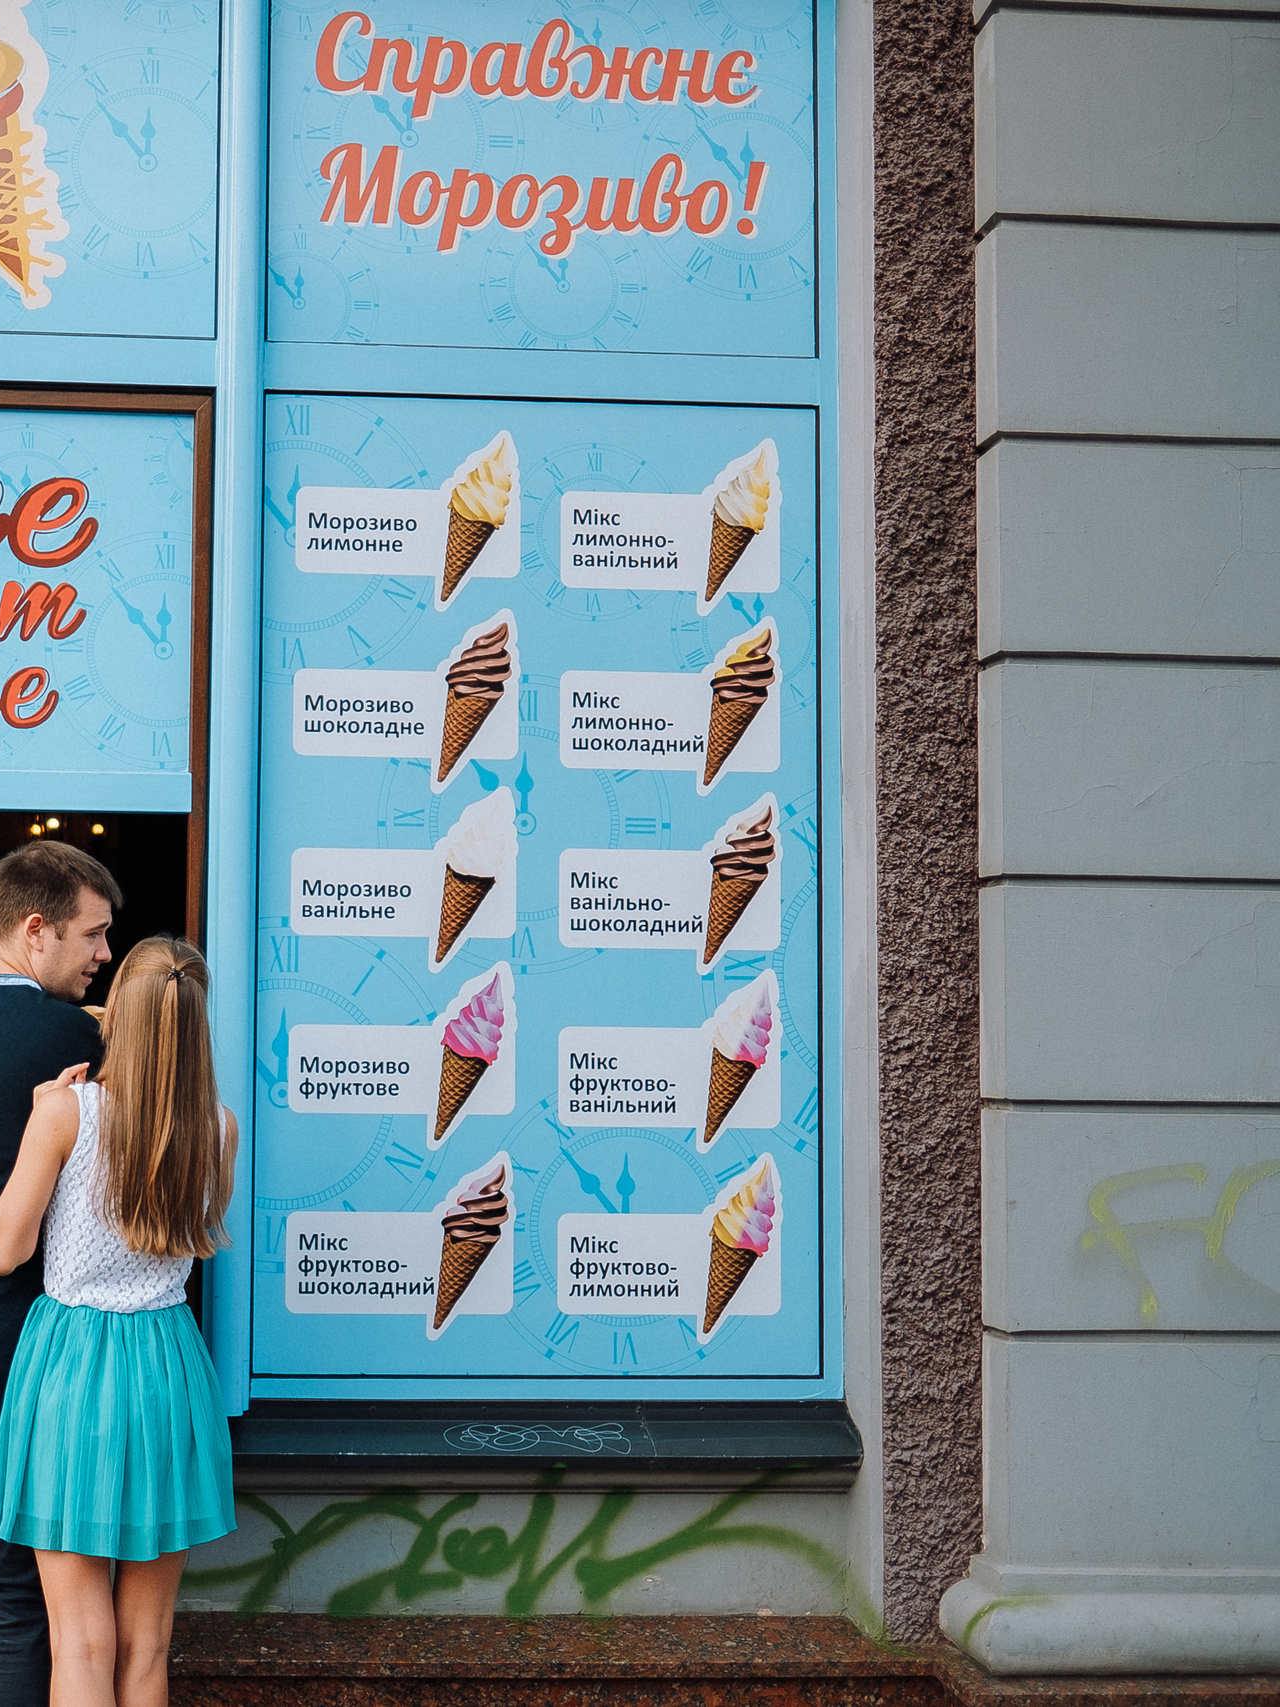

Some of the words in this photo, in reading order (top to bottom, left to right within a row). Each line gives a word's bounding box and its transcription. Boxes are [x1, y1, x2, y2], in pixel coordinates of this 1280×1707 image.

[315, 10, 761, 120] Справжнє
[320, 142, 768, 257] Морозиво!
[307, 512, 418, 534] Морозиво
[572, 508, 621, 526] Мікс
[307, 536, 404, 553] лимонне
[572, 533, 675, 548] лимонно-
[572, 551, 679, 569] ванільний
[304, 694, 414, 716] Морозиво
[572, 691, 621, 709] Мікс
[304, 719, 425, 738] шоколадне
[571, 716, 674, 731] лимонно-
[572, 735, 705, 755] шоколадний
[302, 879, 412, 900] Морозиво
[570, 872, 619, 889] Мікс
[301, 901, 396, 919] ванільне
[570, 893, 671, 912] ванільно-
[570, 915, 703, 936] шоколадний
[299, 1056, 410, 1078] Морозиво
[570, 1052, 618, 1070] Мікс
[298, 1078, 400, 1100] фруктове
[569, 1074, 676, 1095] фруктово-
[569, 1096, 677, 1114] ванільний
[298, 1233, 349, 1251] Мікс
[570, 1236, 619, 1254] Мікс
[298, 1255, 408, 1277] фруктово-
[569, 1258, 677, 1279] фруктово-
[298, 1277, 436, 1299] шоколадний
[569, 1279, 680, 1298] лимонний
